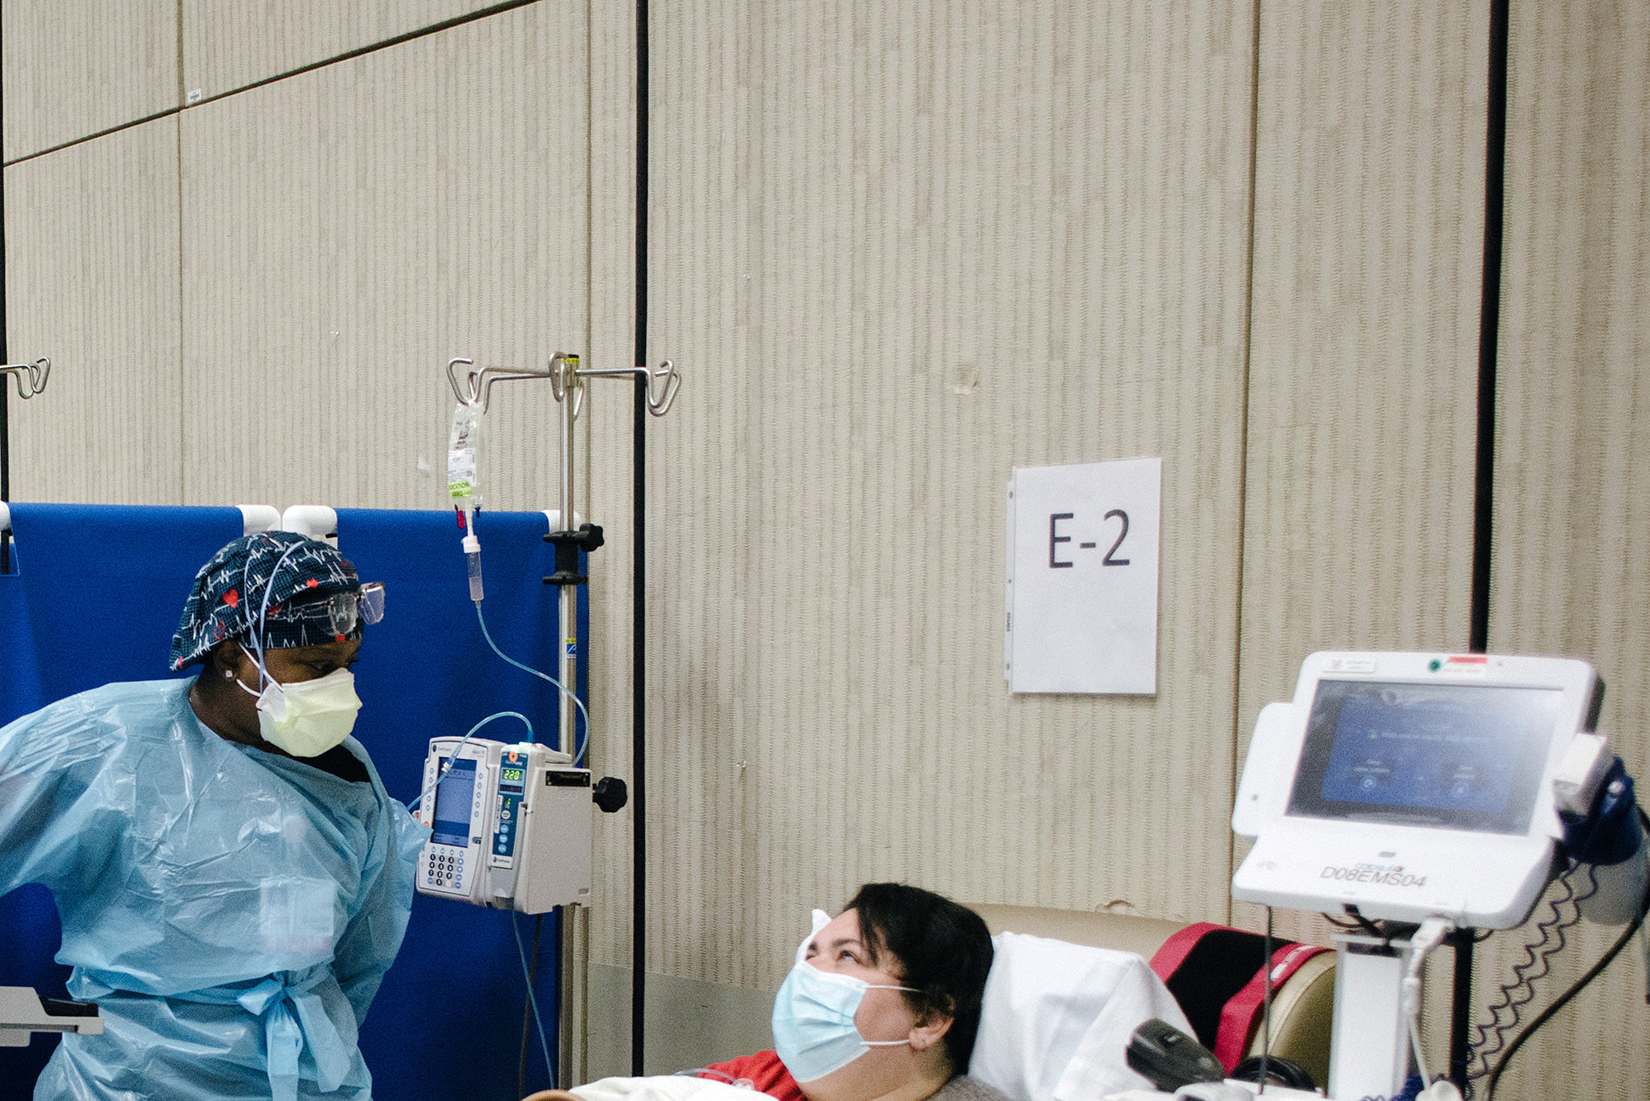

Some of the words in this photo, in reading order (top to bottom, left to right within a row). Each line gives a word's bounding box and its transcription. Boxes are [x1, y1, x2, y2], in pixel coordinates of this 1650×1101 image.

[1049, 509, 1130, 569] E-2
[504, 770, 520, 781] 220
[1320, 866, 1426, 887] D08EMS04
